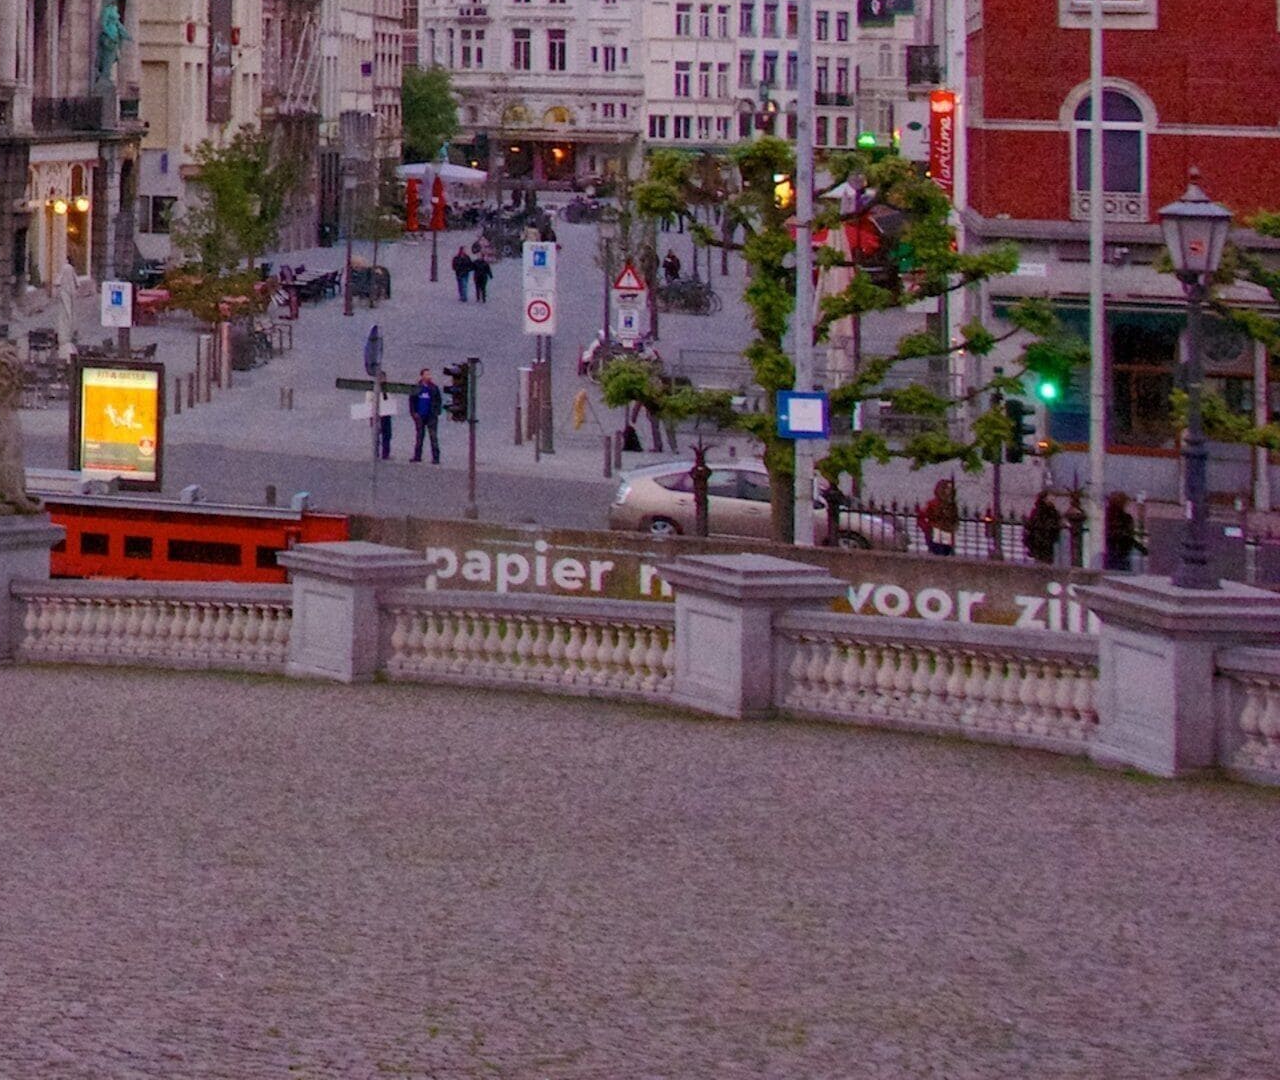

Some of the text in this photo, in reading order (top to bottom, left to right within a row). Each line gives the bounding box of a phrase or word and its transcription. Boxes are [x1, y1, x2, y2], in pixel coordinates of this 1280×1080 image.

[532, 306, 546, 317] 30
[425, 540, 615, 595] papier
[846, 581, 987, 622] voor
[1014, 581, 1102, 635] zij
